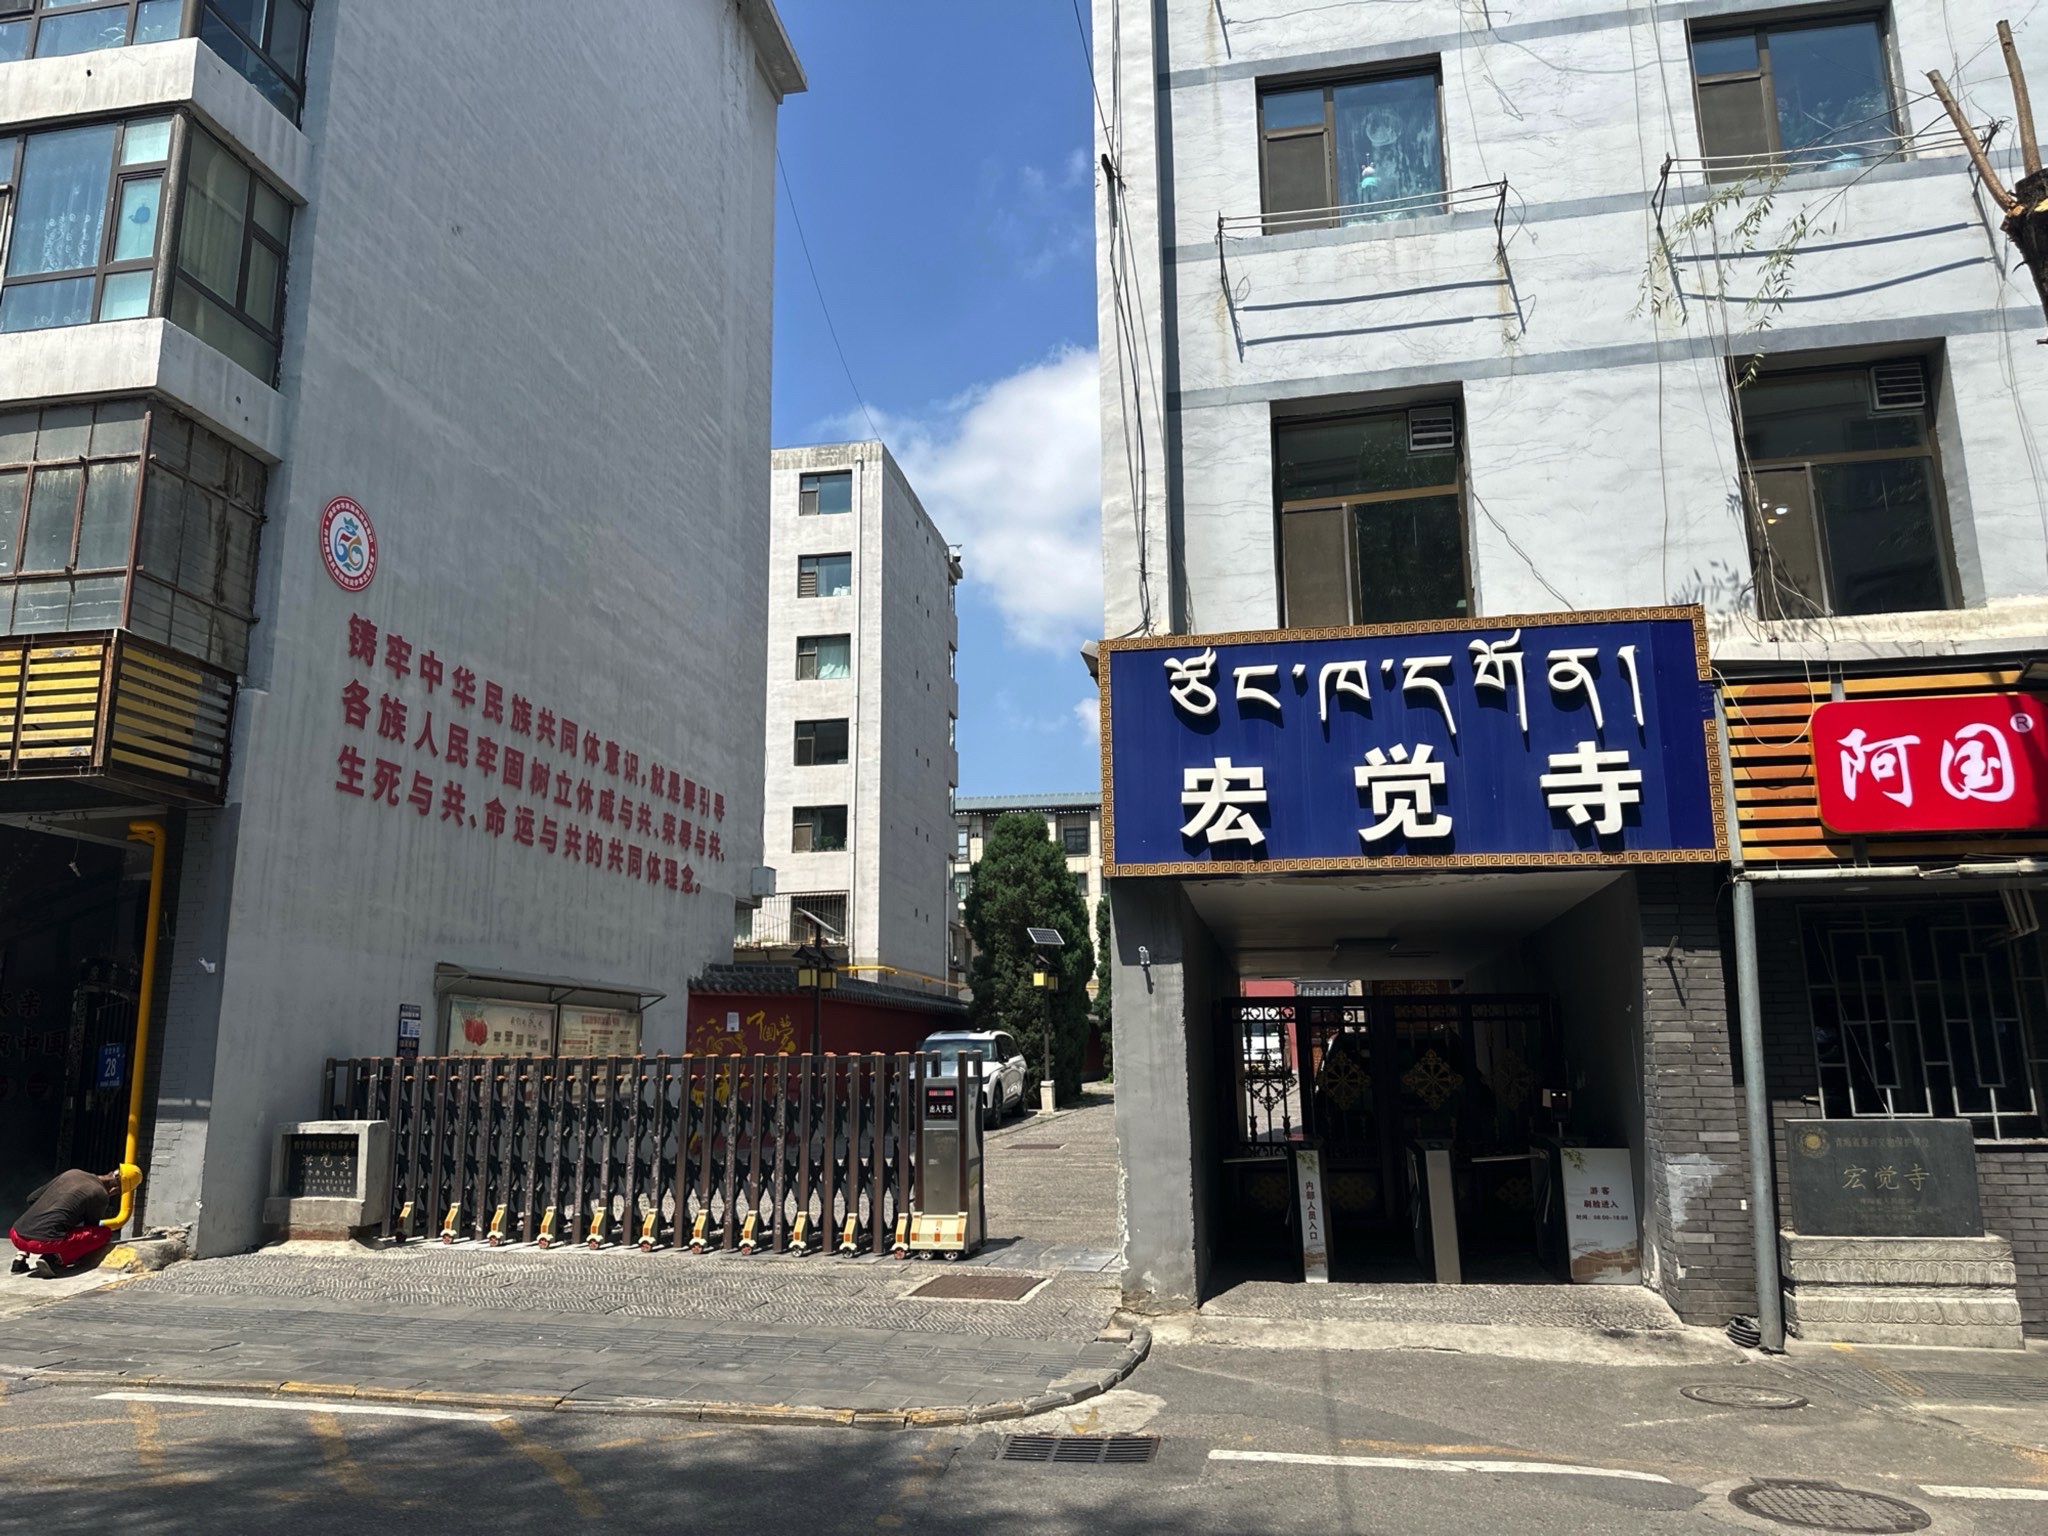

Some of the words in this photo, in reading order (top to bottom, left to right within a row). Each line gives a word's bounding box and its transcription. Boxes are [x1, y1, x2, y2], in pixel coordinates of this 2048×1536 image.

[347, 612, 726, 823] 铸牢中华民族共同体意识，就是要引导
[341, 678, 726, 863] 各族人民牢固树立休戚与共、荣辱与共、
[1180, 741, 1643, 846] 宏觉寺
[1837, 722, 2016, 809] 阿国
[335, 744, 702, 895] 生死与共、命运与共的共同体理念。
[104, 1057, 117, 1077] 28
[929, 1104, 953, 1114] 出入平安
[1583, 1199, 1619, 1209] 刷脸进入
[1589, 1186, 1610, 1196] 游客
[1842, 1163, 1930, 1191] 宏觉寺
[1305, 1181, 1318, 1240] 内部人员入口
